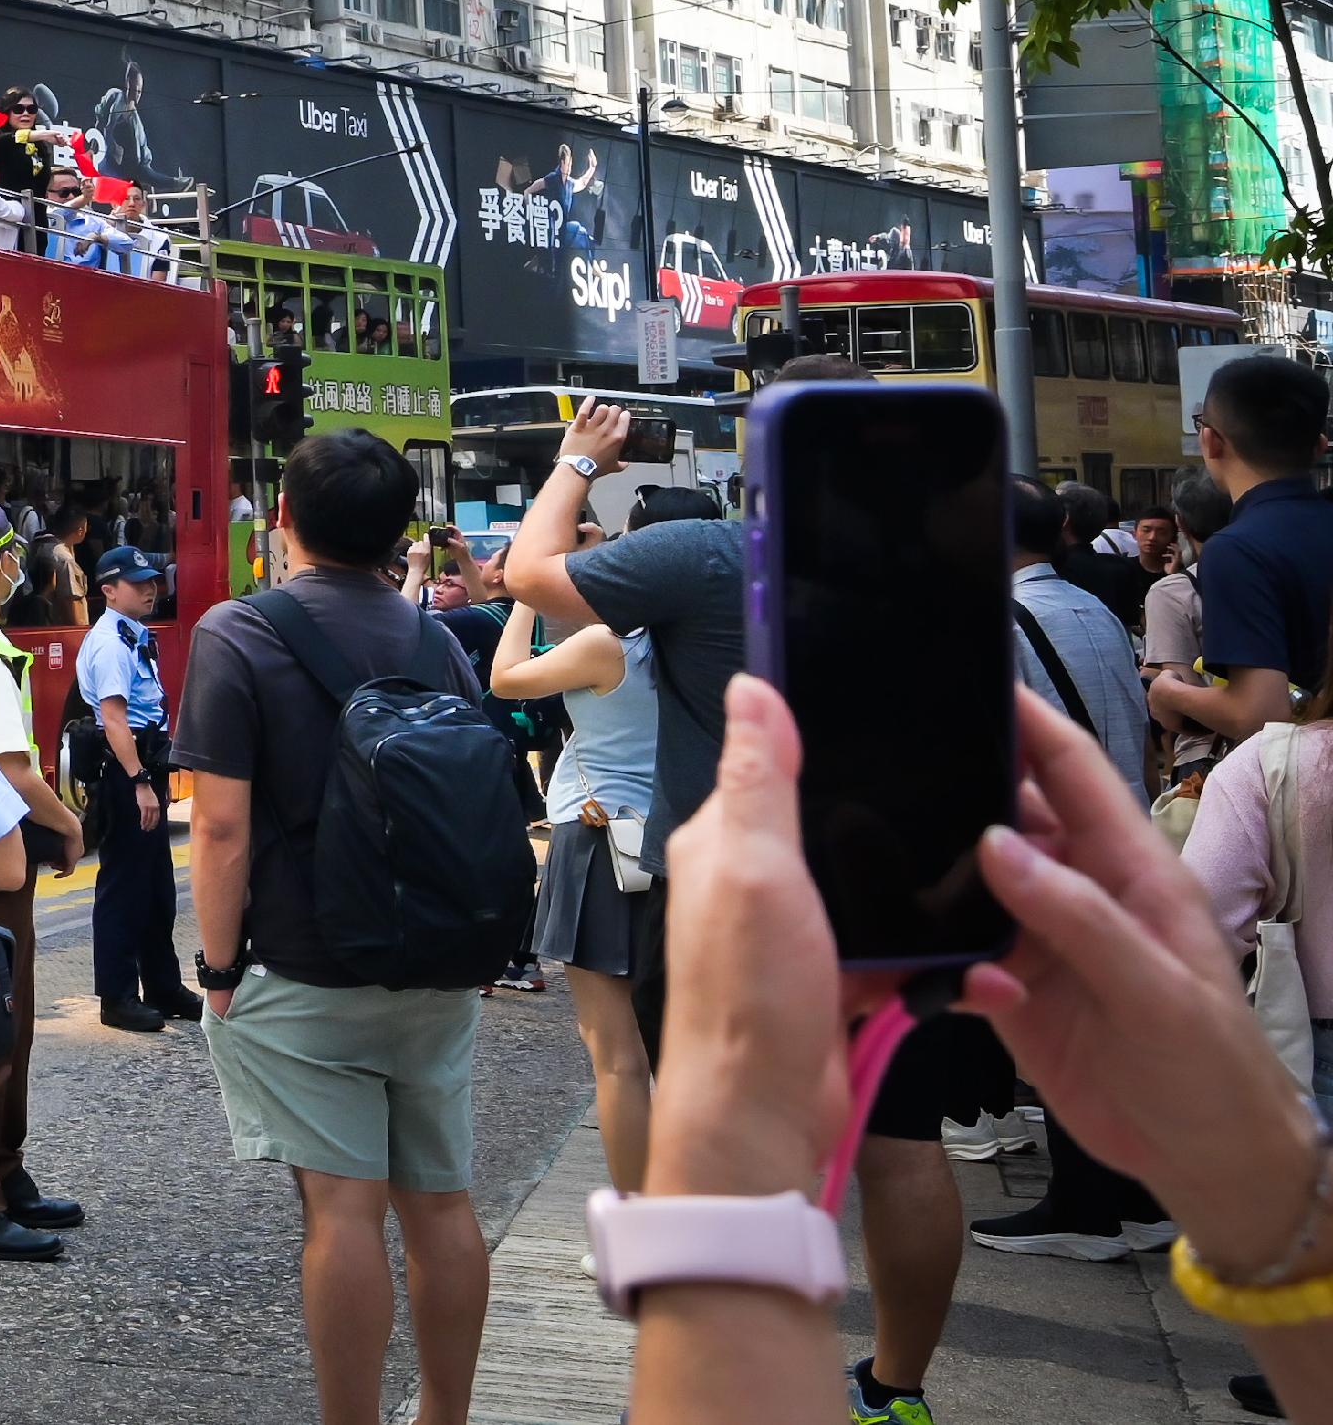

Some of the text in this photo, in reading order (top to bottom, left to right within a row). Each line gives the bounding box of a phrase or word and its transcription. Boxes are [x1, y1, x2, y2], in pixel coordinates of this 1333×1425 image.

[299, 99, 368, 138] Uber Taxi
[690, 170, 738, 202] Uber Taxi
[963, 220, 982, 244] Uber
[570, 256, 632, 323] Skip!
